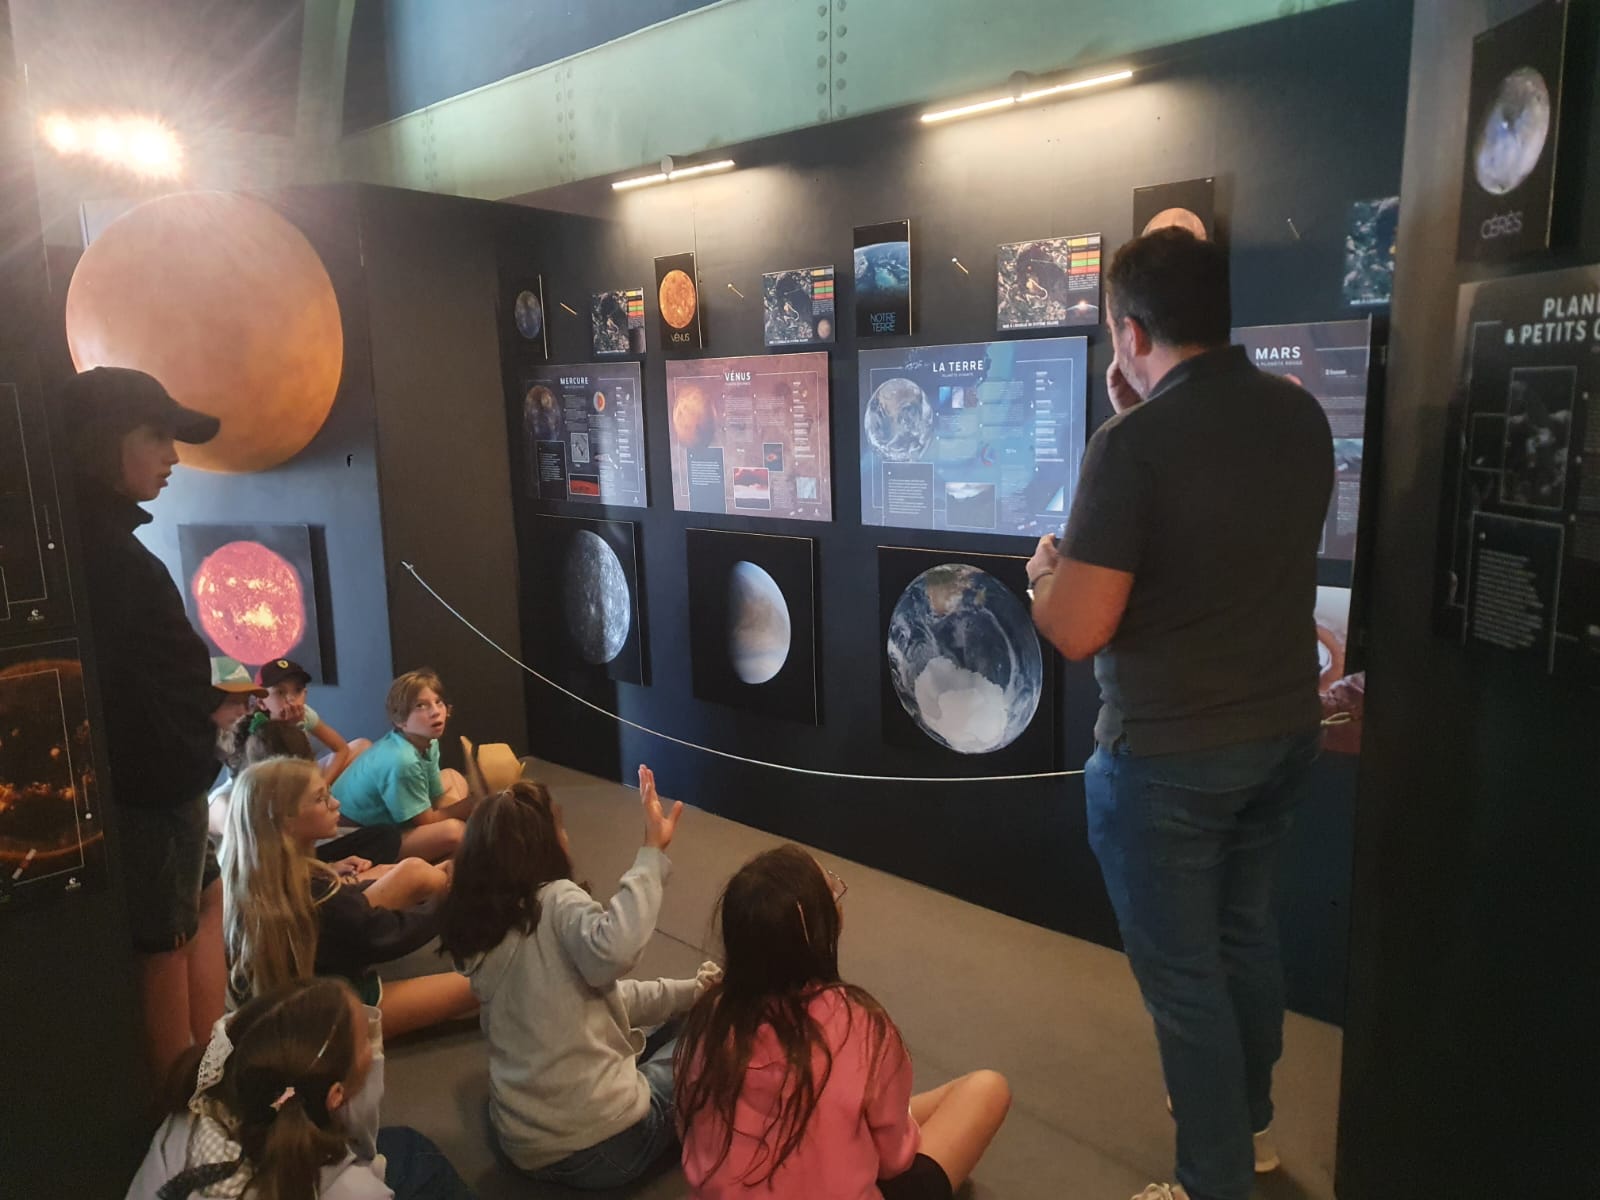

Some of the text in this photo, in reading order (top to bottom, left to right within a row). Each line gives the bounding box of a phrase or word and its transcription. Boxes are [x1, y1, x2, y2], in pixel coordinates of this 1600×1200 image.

[1543, 293, 1600, 319] PLAN
[1519, 320, 1587, 345] PETITS
[1255, 346, 1301, 360] MARS
[932, 360, 984, 373] LA TERRE
[559, 377, 589, 385] MERCURE
